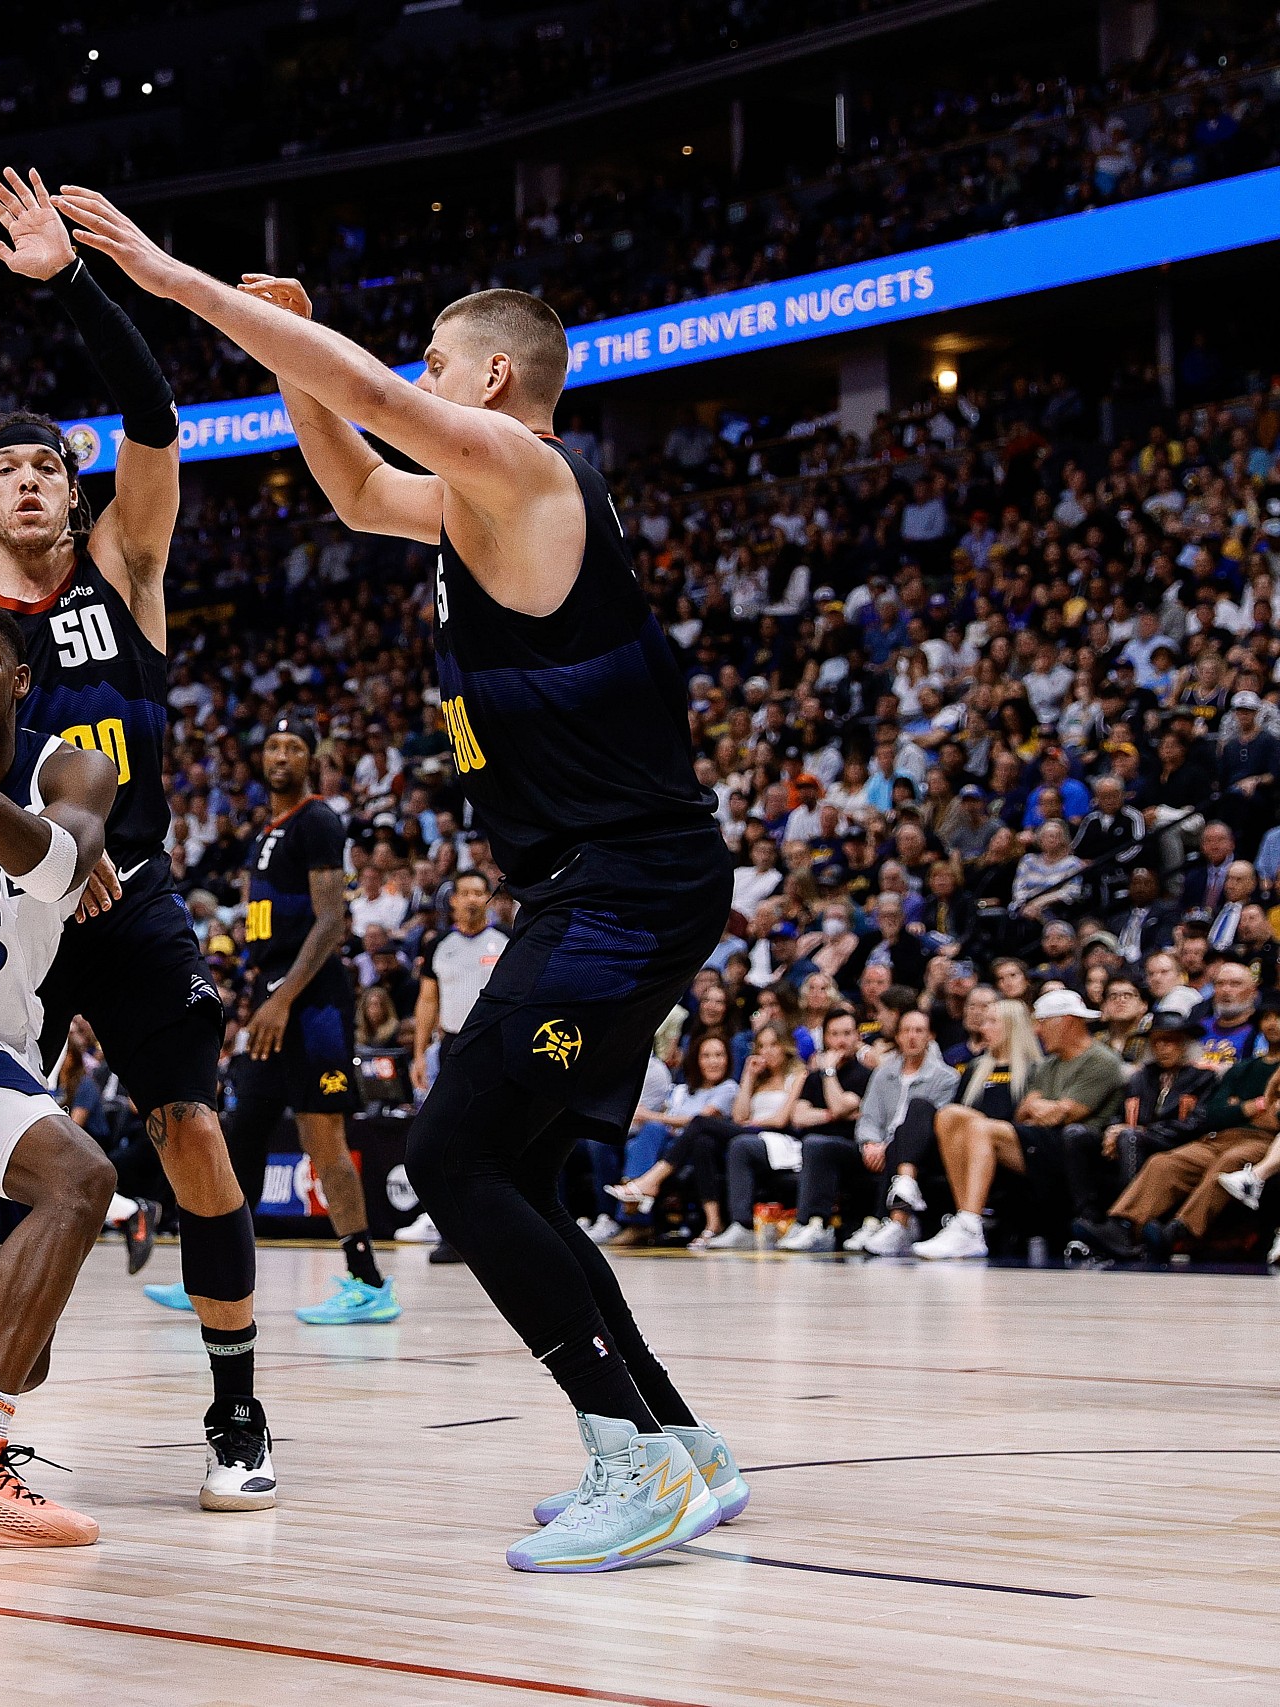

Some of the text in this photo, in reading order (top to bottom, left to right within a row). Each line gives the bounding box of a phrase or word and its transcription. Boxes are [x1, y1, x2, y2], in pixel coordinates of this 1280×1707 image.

[593, 327, 651, 367] THE
[658, 301, 777, 355] DENVER
[784, 266, 934, 327] NUGGETS
[60, 584, 94, 608] ibotta
[49, 603, 118, 668] 50
[233, 1404, 250, 1417] 361
